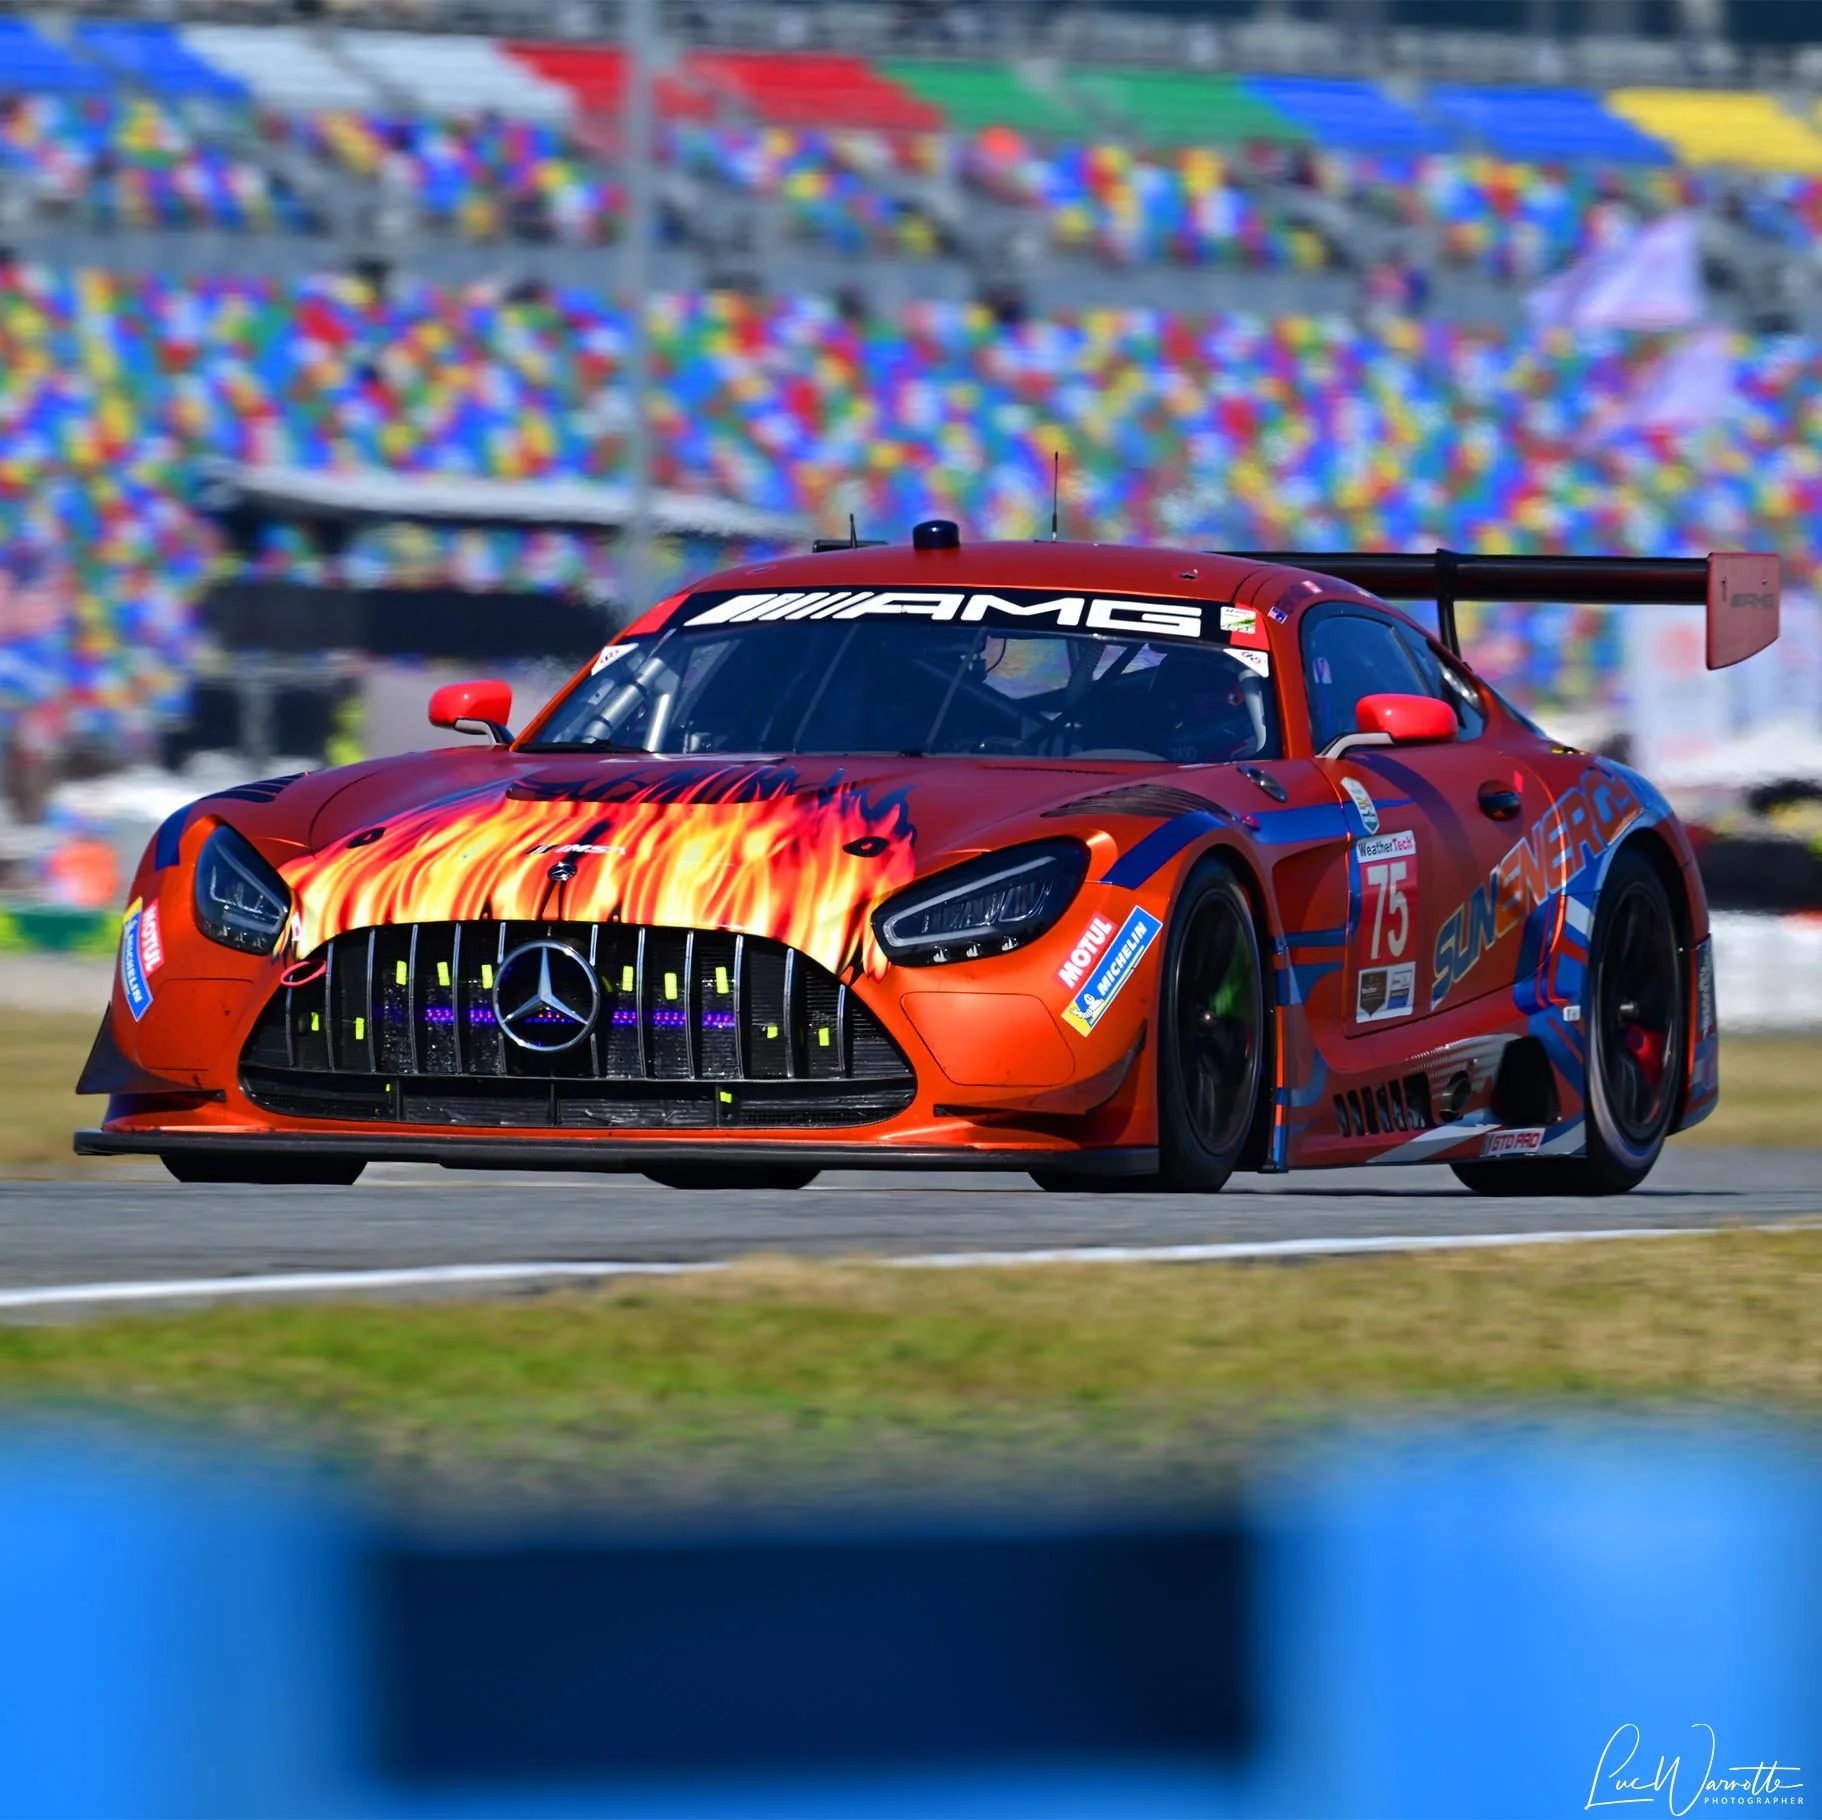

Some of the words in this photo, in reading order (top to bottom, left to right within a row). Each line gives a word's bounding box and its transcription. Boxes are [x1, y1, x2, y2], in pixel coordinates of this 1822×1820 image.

[841, 592, 1201, 637] AMG
[555, 844, 626, 856] IMSA
[1358, 836, 1414, 857] WeatherTech
[142, 903, 161, 973] MOTUL
[1367, 861, 1409, 960] 75
[126, 933, 144, 1004] MICHELIN
[1058, 917, 1113, 989] MOTUL
[1096, 921, 1148, 996] MICHELIN
[1514, 1131, 1541, 1149] PRO
